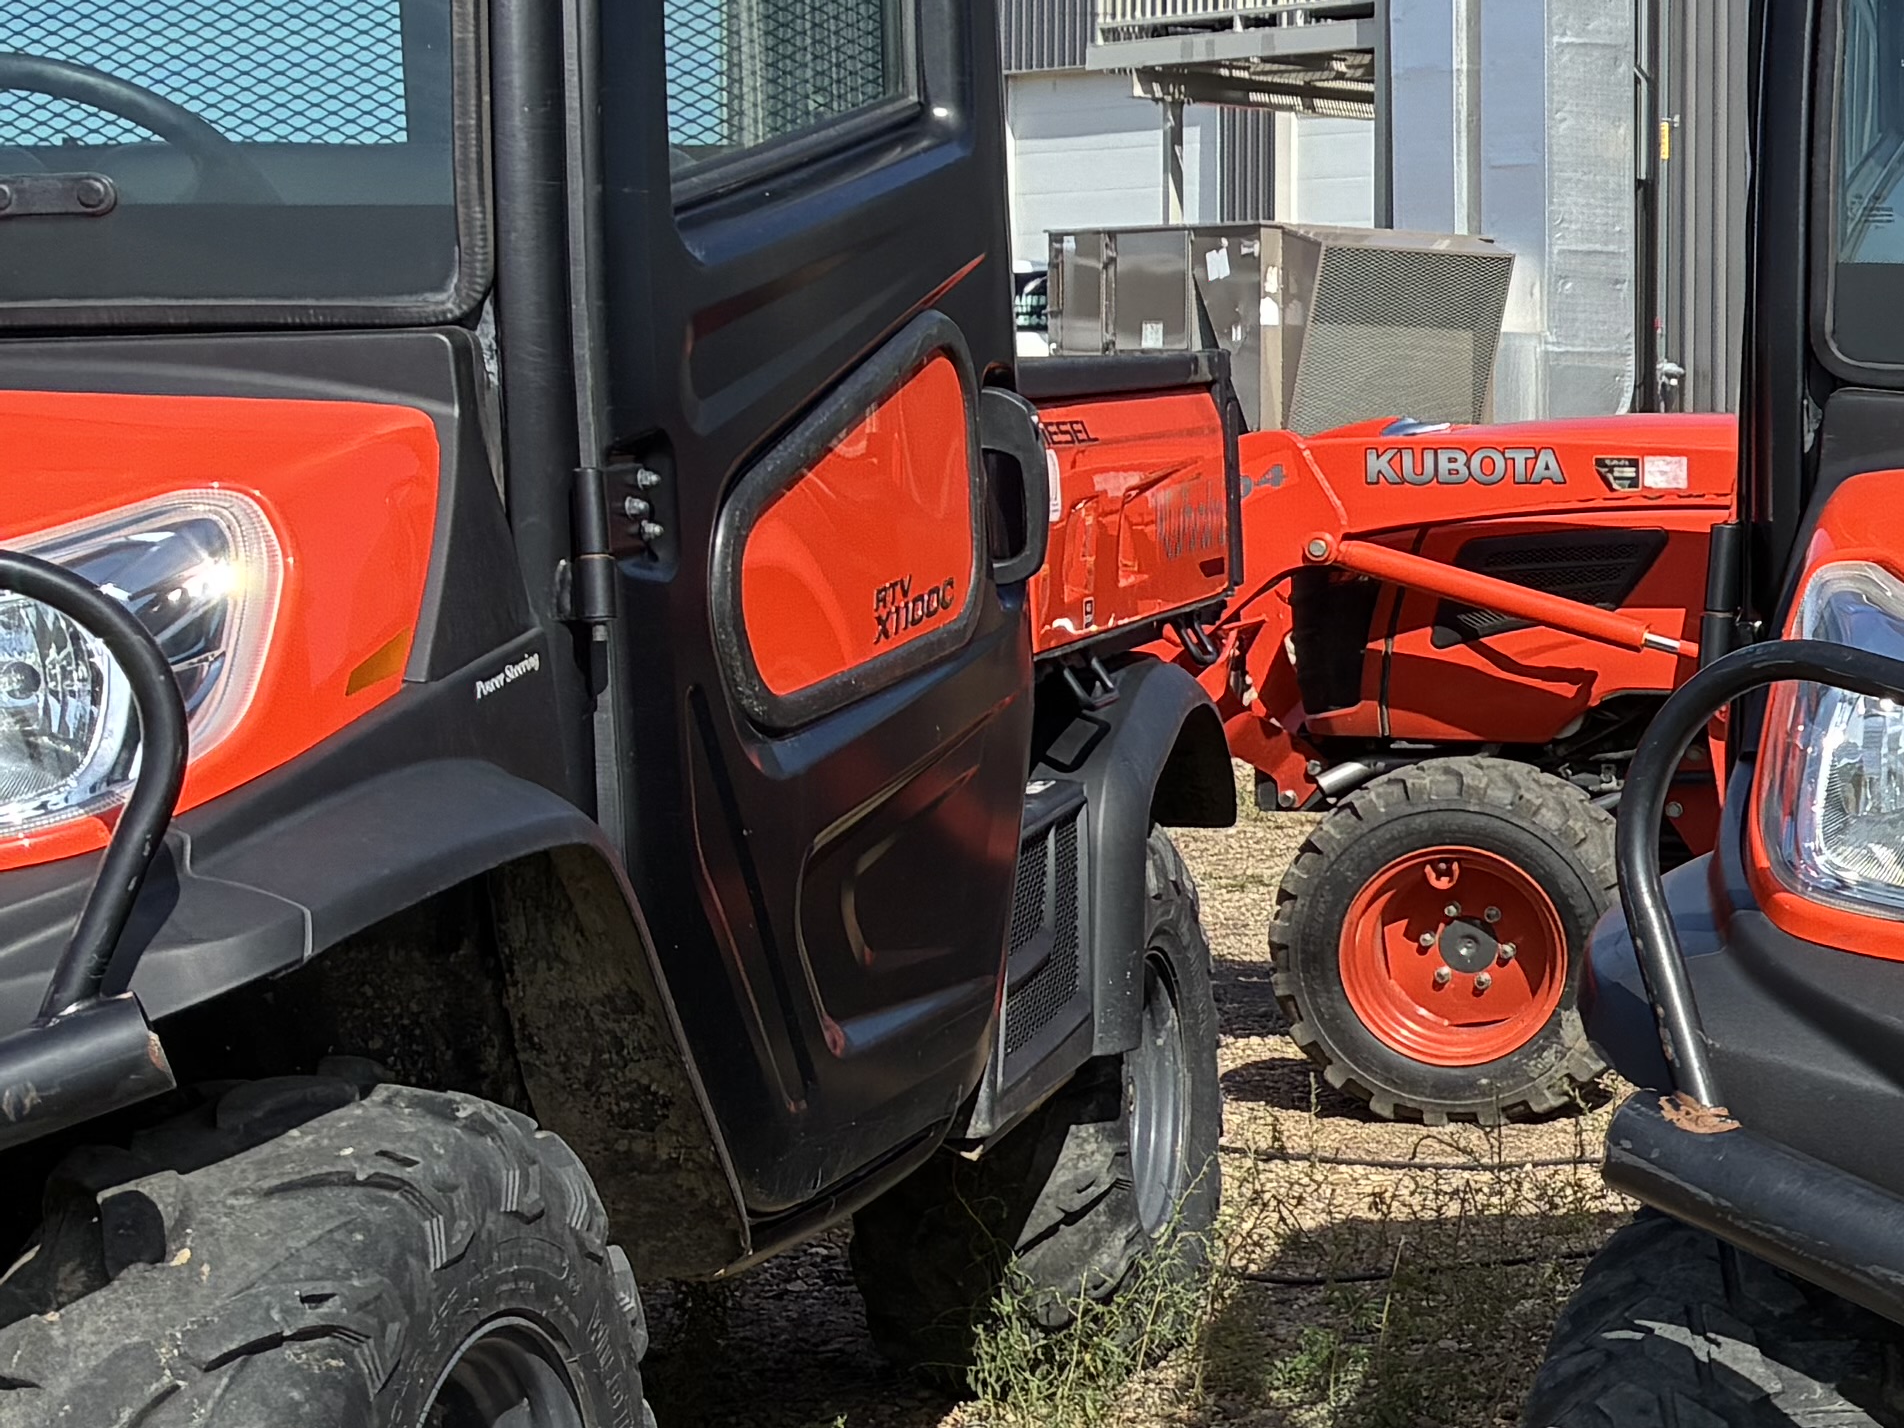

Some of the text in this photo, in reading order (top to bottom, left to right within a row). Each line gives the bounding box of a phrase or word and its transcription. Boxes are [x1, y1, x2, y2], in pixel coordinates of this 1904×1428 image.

[1040, 420, 1099, 446] IESEL
[1364, 447, 1567, 486] KUBOTA
[873, 573, 912, 613] RTV
[873, 576, 955, 647] X1100C
